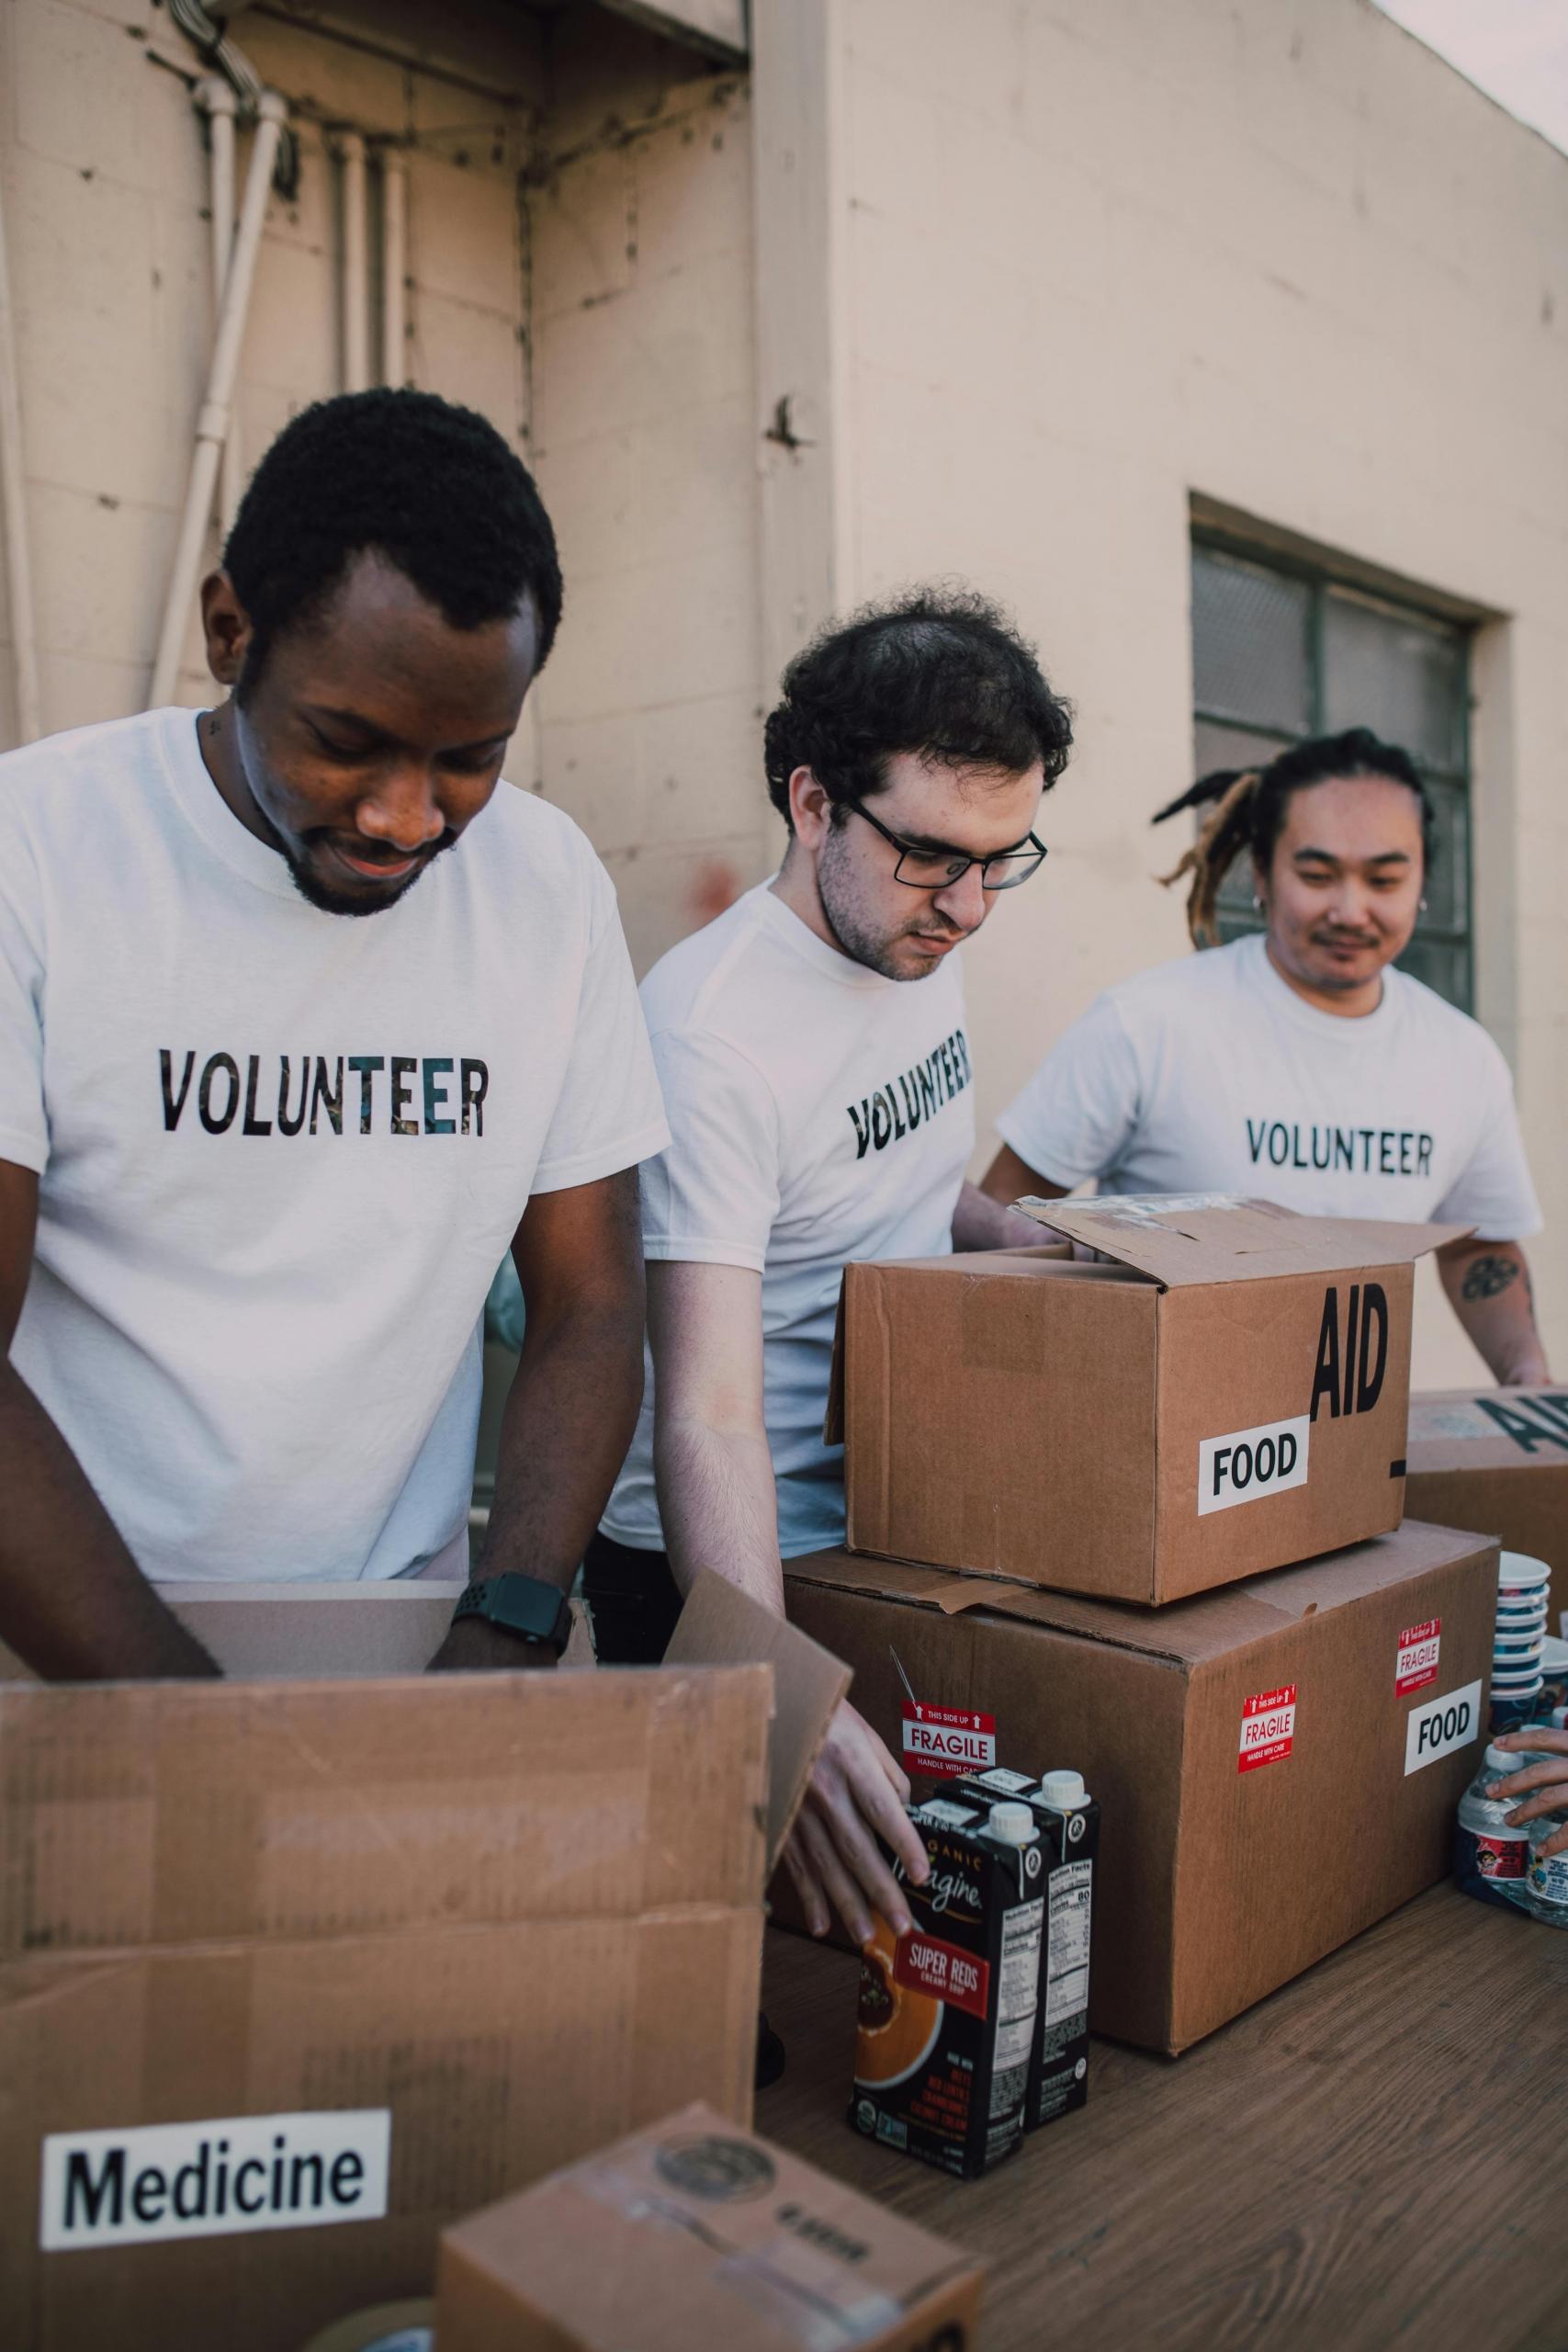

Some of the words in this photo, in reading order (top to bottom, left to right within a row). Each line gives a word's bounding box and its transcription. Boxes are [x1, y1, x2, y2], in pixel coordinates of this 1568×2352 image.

[159, 1048, 489, 1137] VOLUNTEER
[846, 1029, 972, 1160] VOLUNTEER
[1247, 1118, 1433, 1176] VOLUNTEER
[1310, 1283, 1388, 1422] AID
[1474, 1394, 1568, 1453] AI
[1213, 1432, 1297, 1496] FOOD
[1401, 1644, 1437, 1672] FRAGILE
[928, 1711, 942, 1721] THIS
[943, 1713, 958, 1723] SIDE
[959, 1716, 969, 1724] UP
[1246, 1713, 1291, 1745] FRAGILE
[1418, 1702, 1470, 1754] FOOD
[911, 1728, 987, 1760] FRAGILE
[918, 1758, 943, 1770] HANDLE
[945, 1763, 961, 1773] WITH
[1274, 1743, 1285, 1754] CARE
[928, 1839, 982, 1872] GANIC
[909, 1943, 947, 1977] SUPER
[951, 1956, 977, 1992] REDS
[62, 2133, 365, 2231] Medicine
